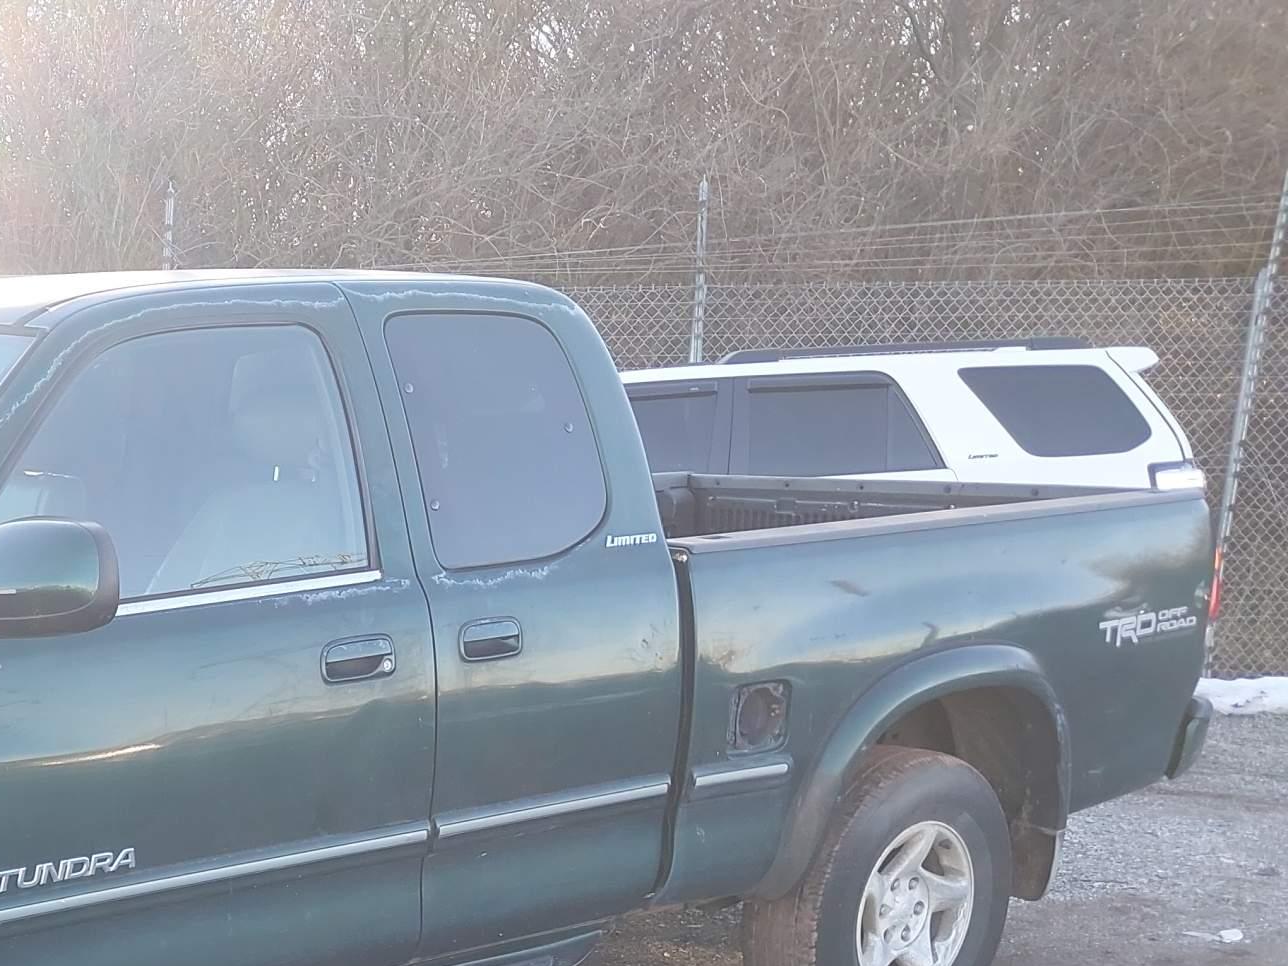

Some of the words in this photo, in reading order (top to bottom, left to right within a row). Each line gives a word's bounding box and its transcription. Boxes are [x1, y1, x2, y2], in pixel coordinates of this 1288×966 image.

[605, 533, 657, 547] LIMITED
[1158, 606, 1189, 620] OFF
[1099, 612, 1157, 647] TRD
[1157, 616, 1197, 632] ROAD
